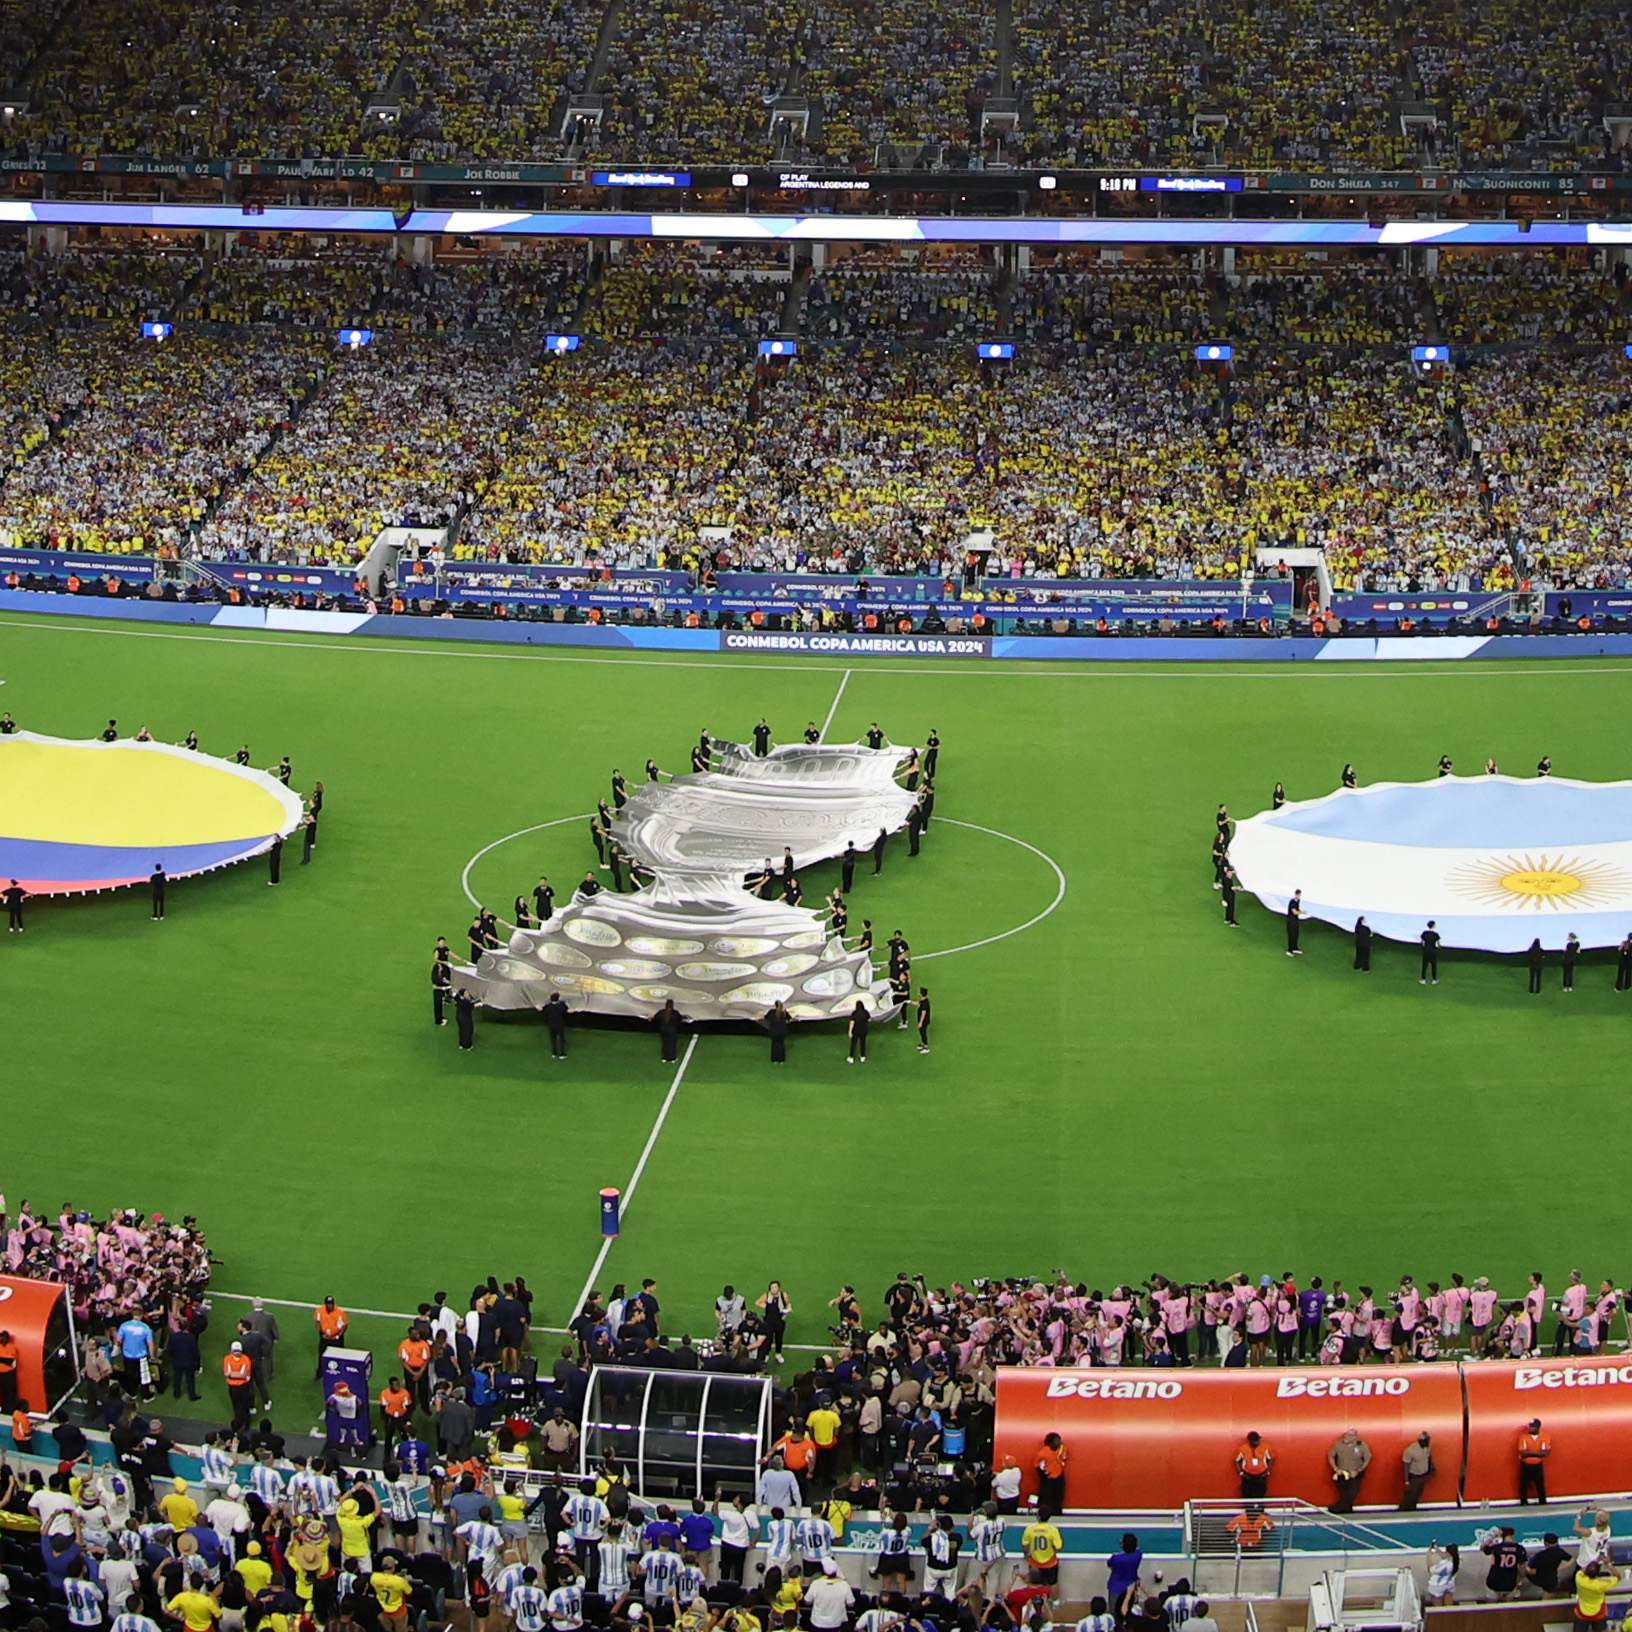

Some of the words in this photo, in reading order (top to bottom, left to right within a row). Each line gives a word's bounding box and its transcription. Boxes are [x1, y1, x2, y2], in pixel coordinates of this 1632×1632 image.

[125, 163, 144, 173] JIM
[147, 163, 186, 174] LANGER
[194, 164, 209, 174] 62
[358, 167, 374, 177] 42
[1310, 178, 1336, 189] DON
[1338, 178, 1372, 189] SHULA
[1558, 178, 1574, 189] 85
[726, 634, 808, 650] CONMEBOL
[809, 637, 850, 651] COPA
[850, 638, 915, 653] AMERICA
[918, 640, 946, 654] USA
[947, 641, 983, 655] 2024
[1046, 1376, 1183, 1399] Betano
[1277, 1374, 1410, 1399] Betano
[579, 1508, 592, 1523] 10
[808, 1535, 822, 1549] 10
[1033, 1535, 1049, 1551] 10
[1499, 1553, 1516, 1567] 10
[654, 1564, 668, 1580] 10
[681, 1577, 694, 1591] 10
[522, 1601, 538, 1617] 10
